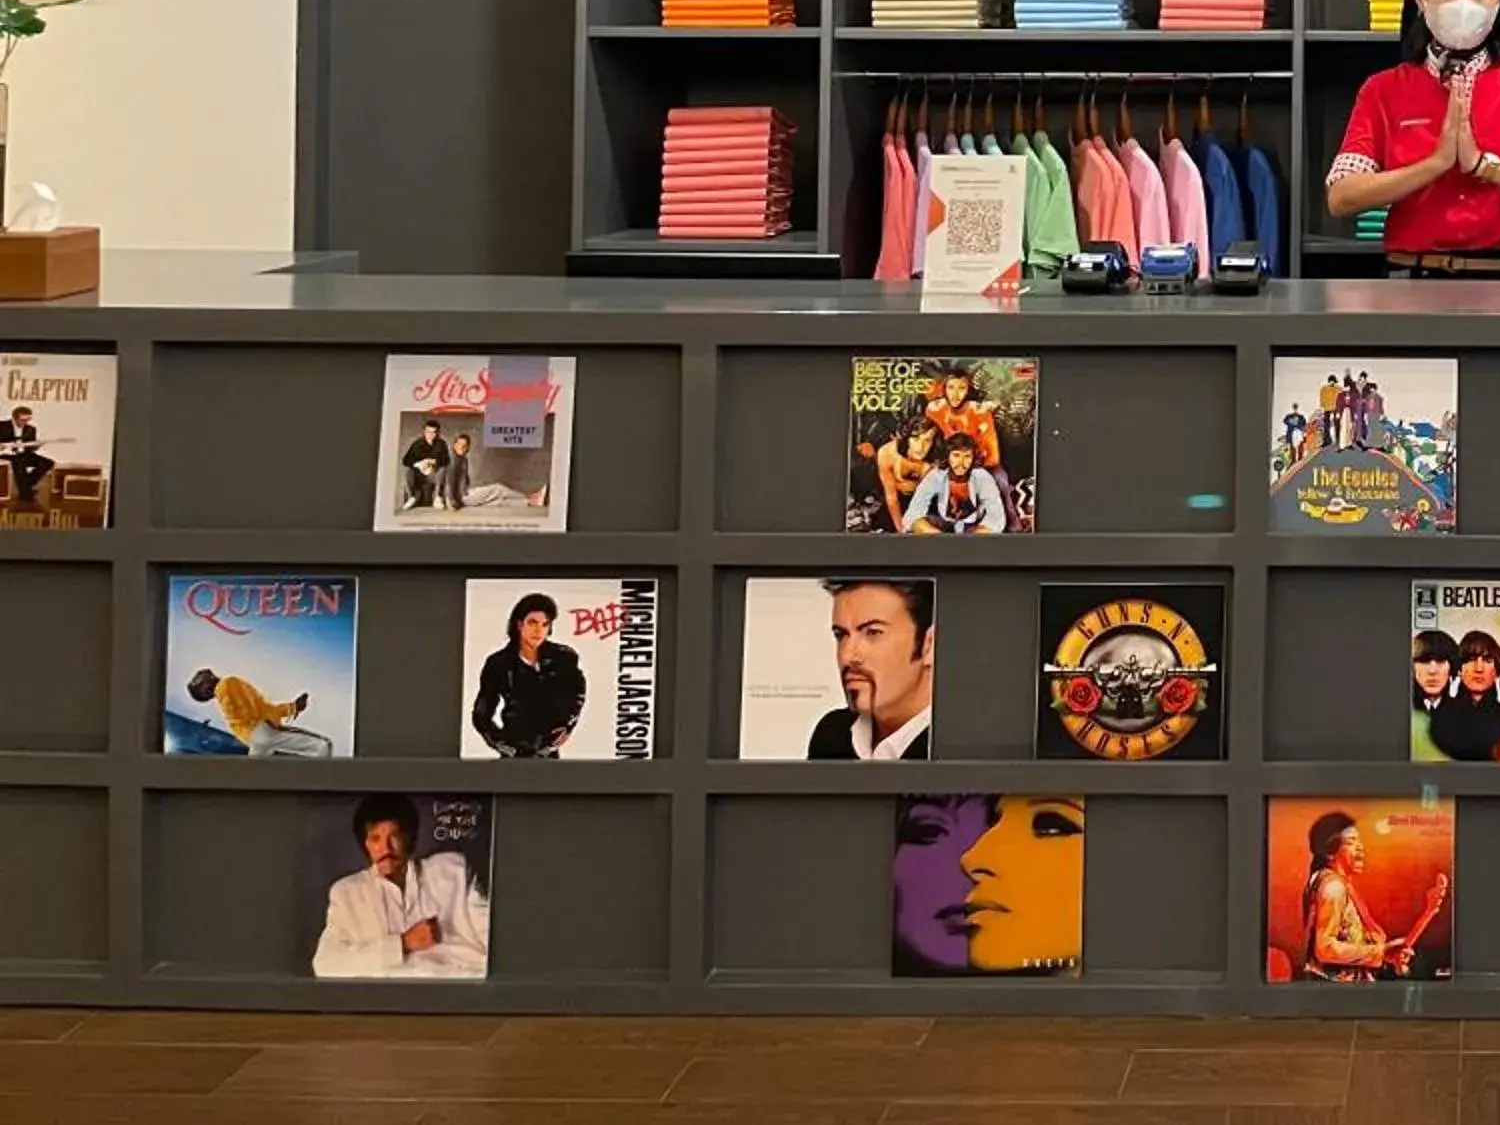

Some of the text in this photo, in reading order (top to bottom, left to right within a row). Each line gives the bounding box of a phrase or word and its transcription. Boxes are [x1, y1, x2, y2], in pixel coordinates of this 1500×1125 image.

[7, 369, 89, 402] CLAPTON
[853, 362, 921, 378] BEST OF
[853, 378, 935, 394] BEE GEES
[184, 580, 345, 635] QUEEN
[618, 580, 656, 673] MICHAEL
